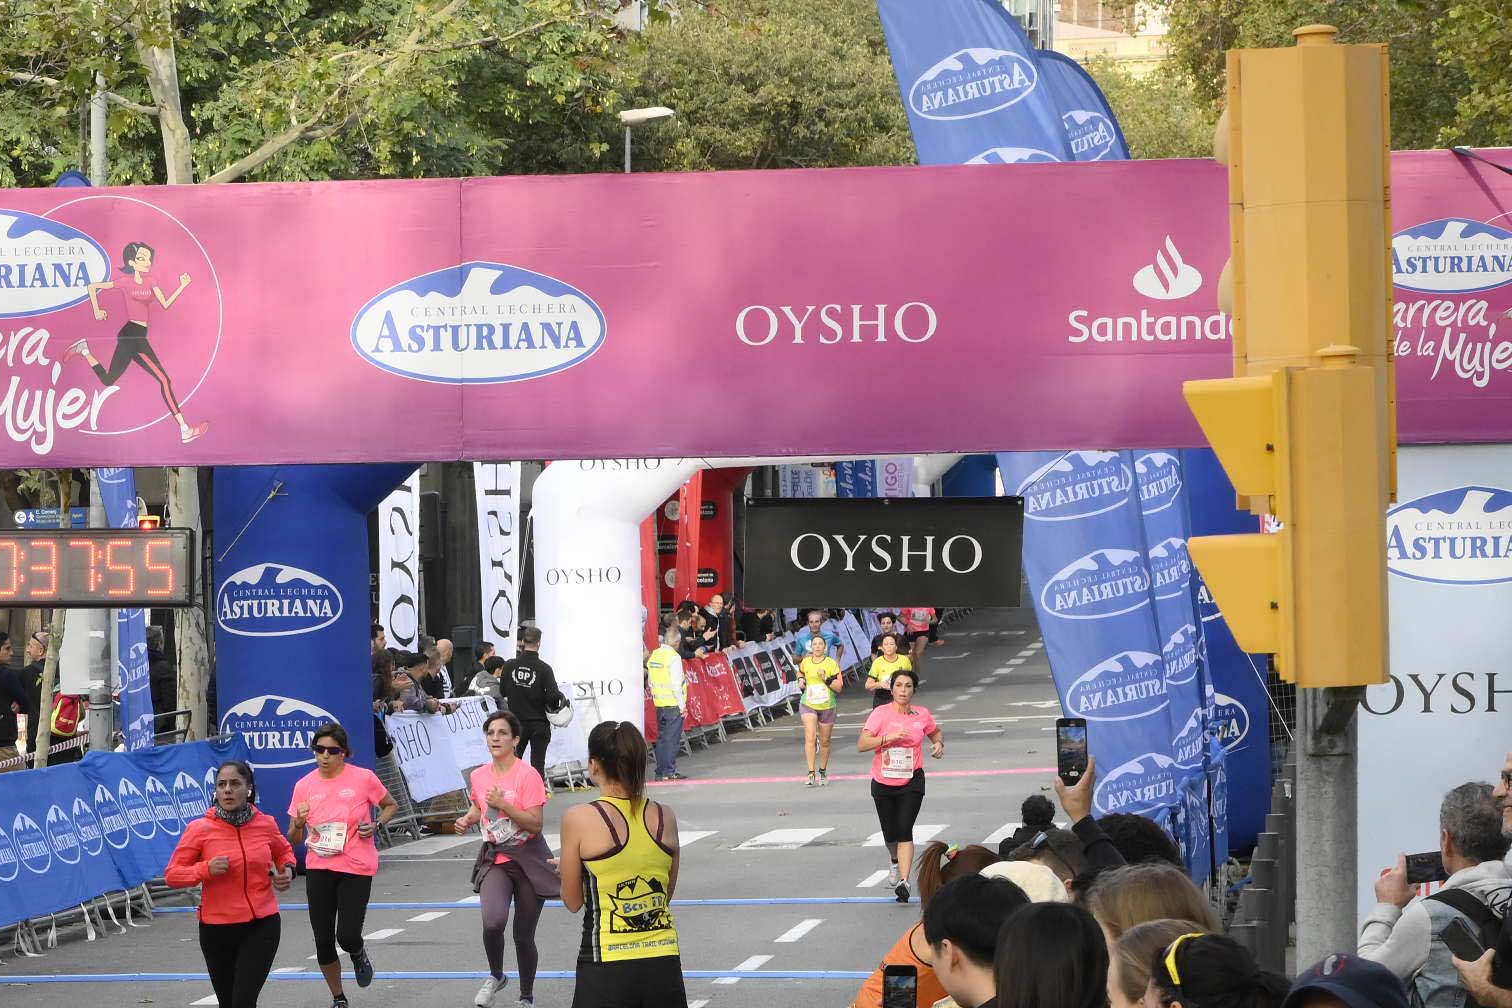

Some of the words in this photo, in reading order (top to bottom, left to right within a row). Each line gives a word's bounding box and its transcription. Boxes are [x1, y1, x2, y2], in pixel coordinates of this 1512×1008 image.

[14, 245, 86, 257] LECHERA
[1408, 243, 1458, 253] CENTRAL
[410, 304, 489, 317] CENTRAL
[496, 302, 579, 315] LECHERA
[1393, 299, 1489, 329] arrera
[372, 310, 587, 354] ASTURIANA
[735, 301, 938, 346] OYSHO
[1417, 329, 1435, 357] la
[1431, 322, 1512, 388] Muje
[1414, 520, 1483, 532] CENTRAL
[1388, 524, 1512, 561] ASTURI
[790, 533, 984, 574] OYSHO
[546, 566, 622, 586] OYSHO
[233, 588, 276, 598] CENTRAL
[280, 587, 330, 597] LECHERA
[221, 591, 334, 622] ASTURIANA
[517, 671, 531, 681] BP
[576, 677, 625, 697] SHO
[1359, 672, 1512, 716] OYSH
[235, 720, 277, 729] CENTRAL
